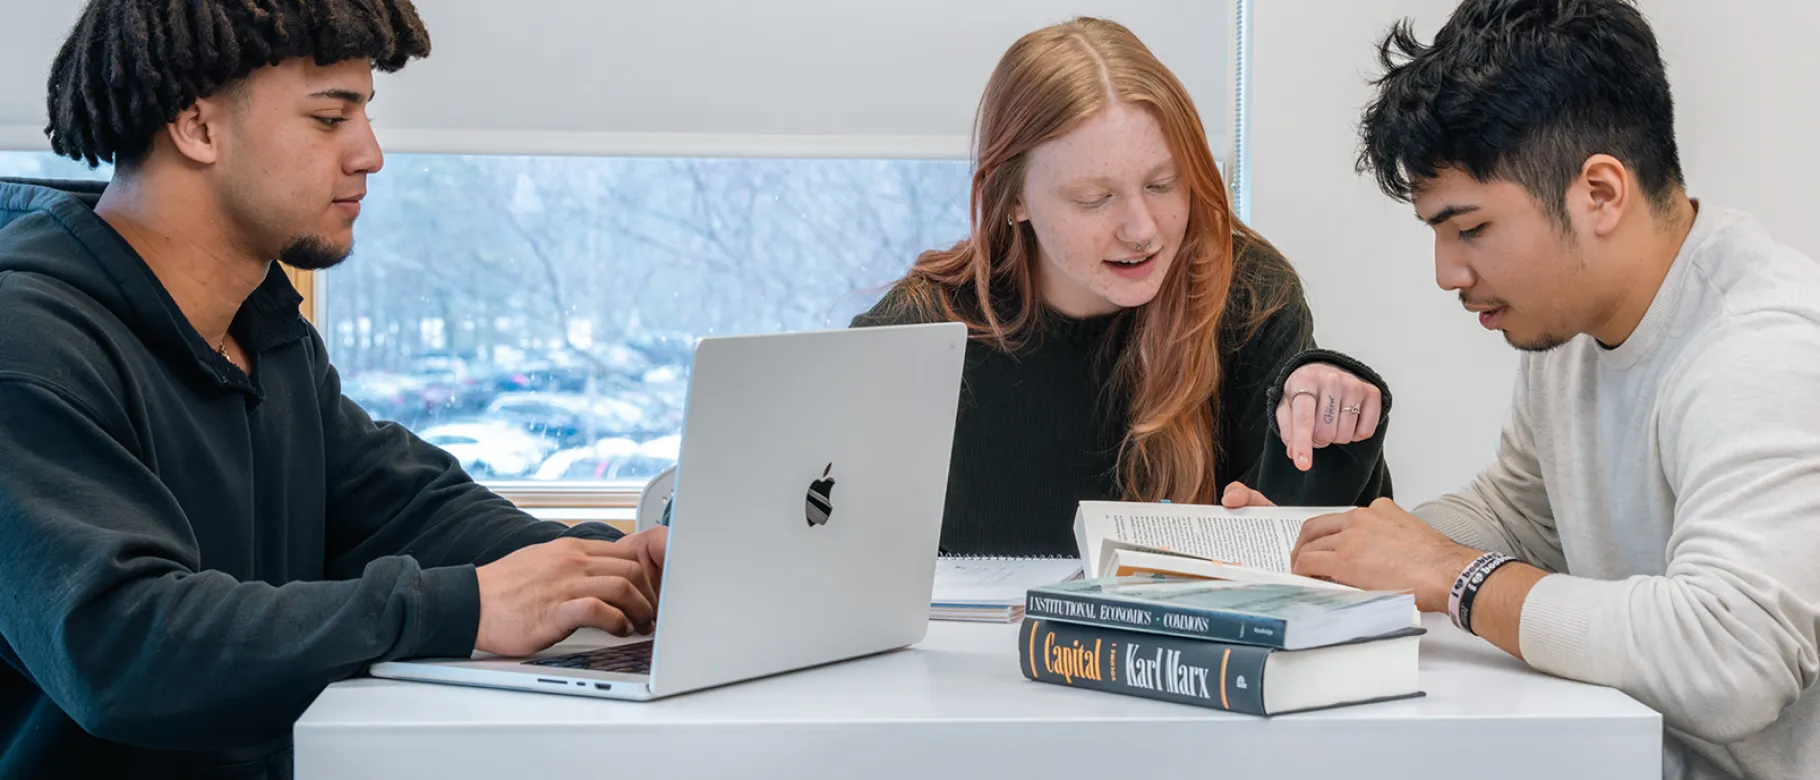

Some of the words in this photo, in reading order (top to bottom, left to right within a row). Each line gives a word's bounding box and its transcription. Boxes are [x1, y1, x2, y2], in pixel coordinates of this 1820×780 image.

[1029, 595, 1096, 619] INSTITUTIONAL
[1100, 605, 1151, 625] ECONOMICS
[1163, 612, 1209, 632] COMMONS
[1044, 631, 1102, 684] Capital
[1109, 649, 1117, 682] VOLUME
[1125, 643, 1162, 692] Karl
[1165, 649, 1210, 699] Marx
